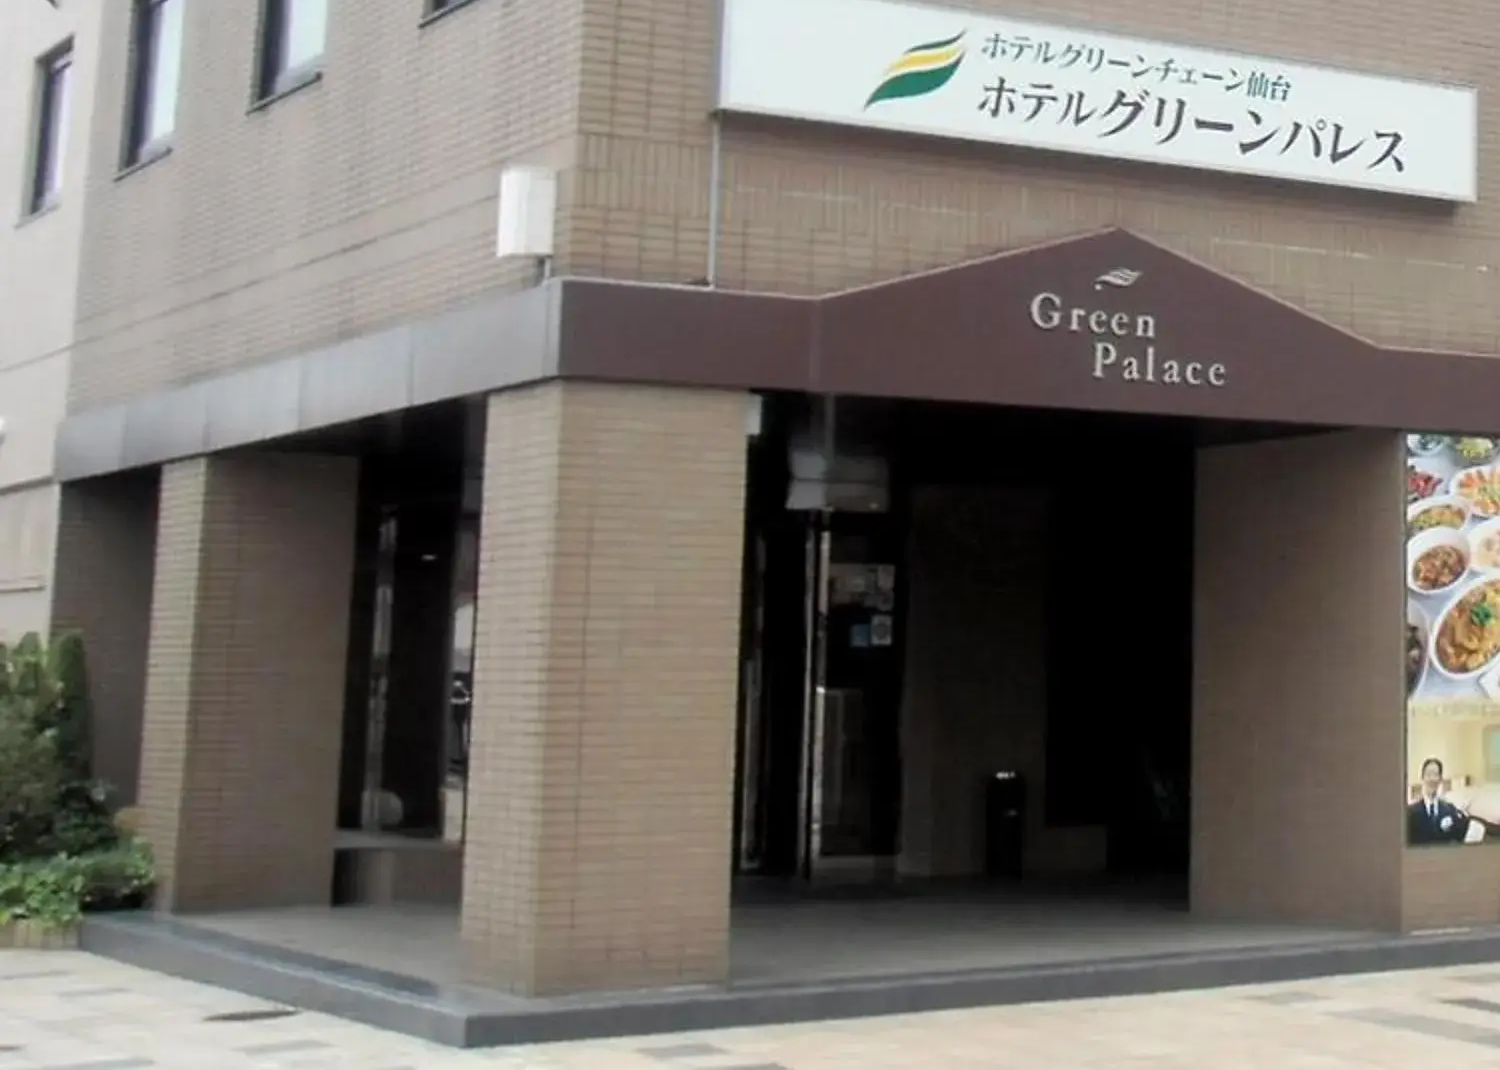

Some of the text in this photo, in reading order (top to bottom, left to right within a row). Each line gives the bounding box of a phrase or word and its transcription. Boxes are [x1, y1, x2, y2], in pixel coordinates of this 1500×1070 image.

[981, 32, 1292, 103] ホテルグリーンチェーン仙台
[977, 76, 1405, 173] ホテルグリーンパレス
[1030, 291, 1156, 339] Green
[1092, 341, 1227, 387] Palace
